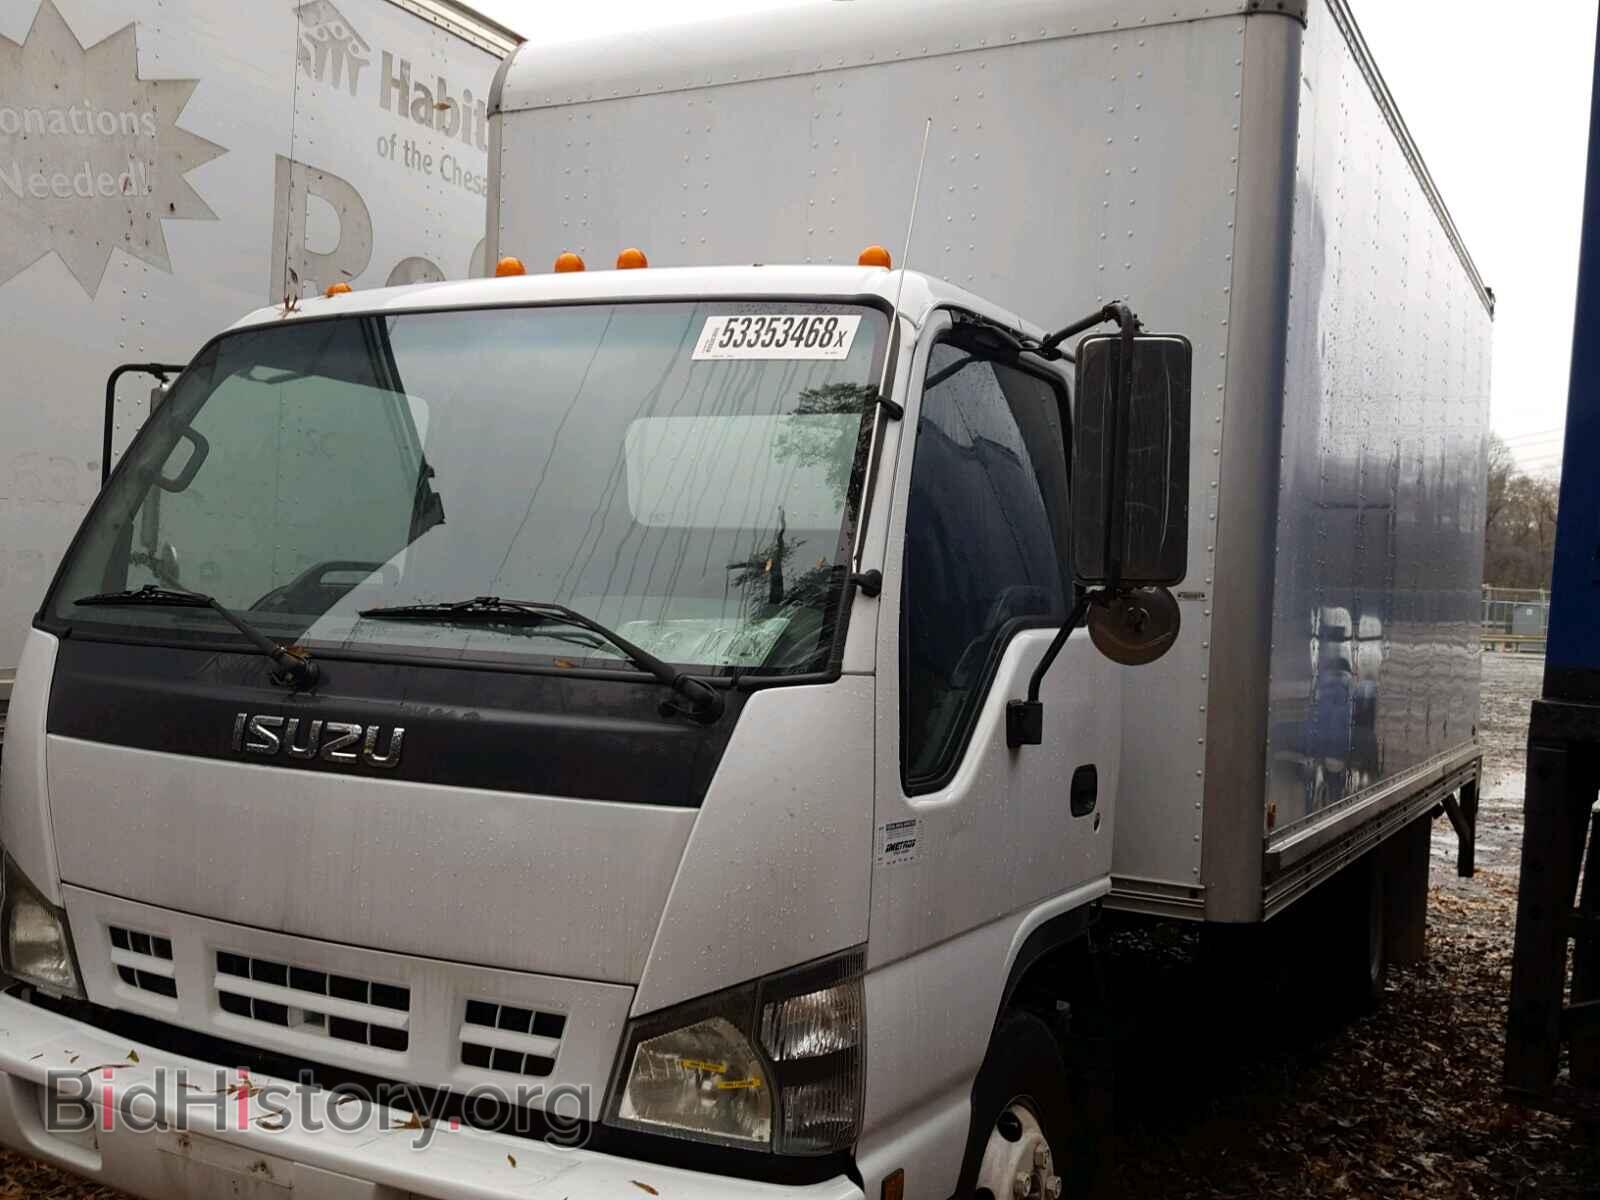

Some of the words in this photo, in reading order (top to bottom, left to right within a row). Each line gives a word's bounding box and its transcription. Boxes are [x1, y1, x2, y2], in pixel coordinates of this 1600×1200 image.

[377, 133, 397, 161] of
[403, 139, 432, 175] the
[231, 712, 405, 768] ISUZU
